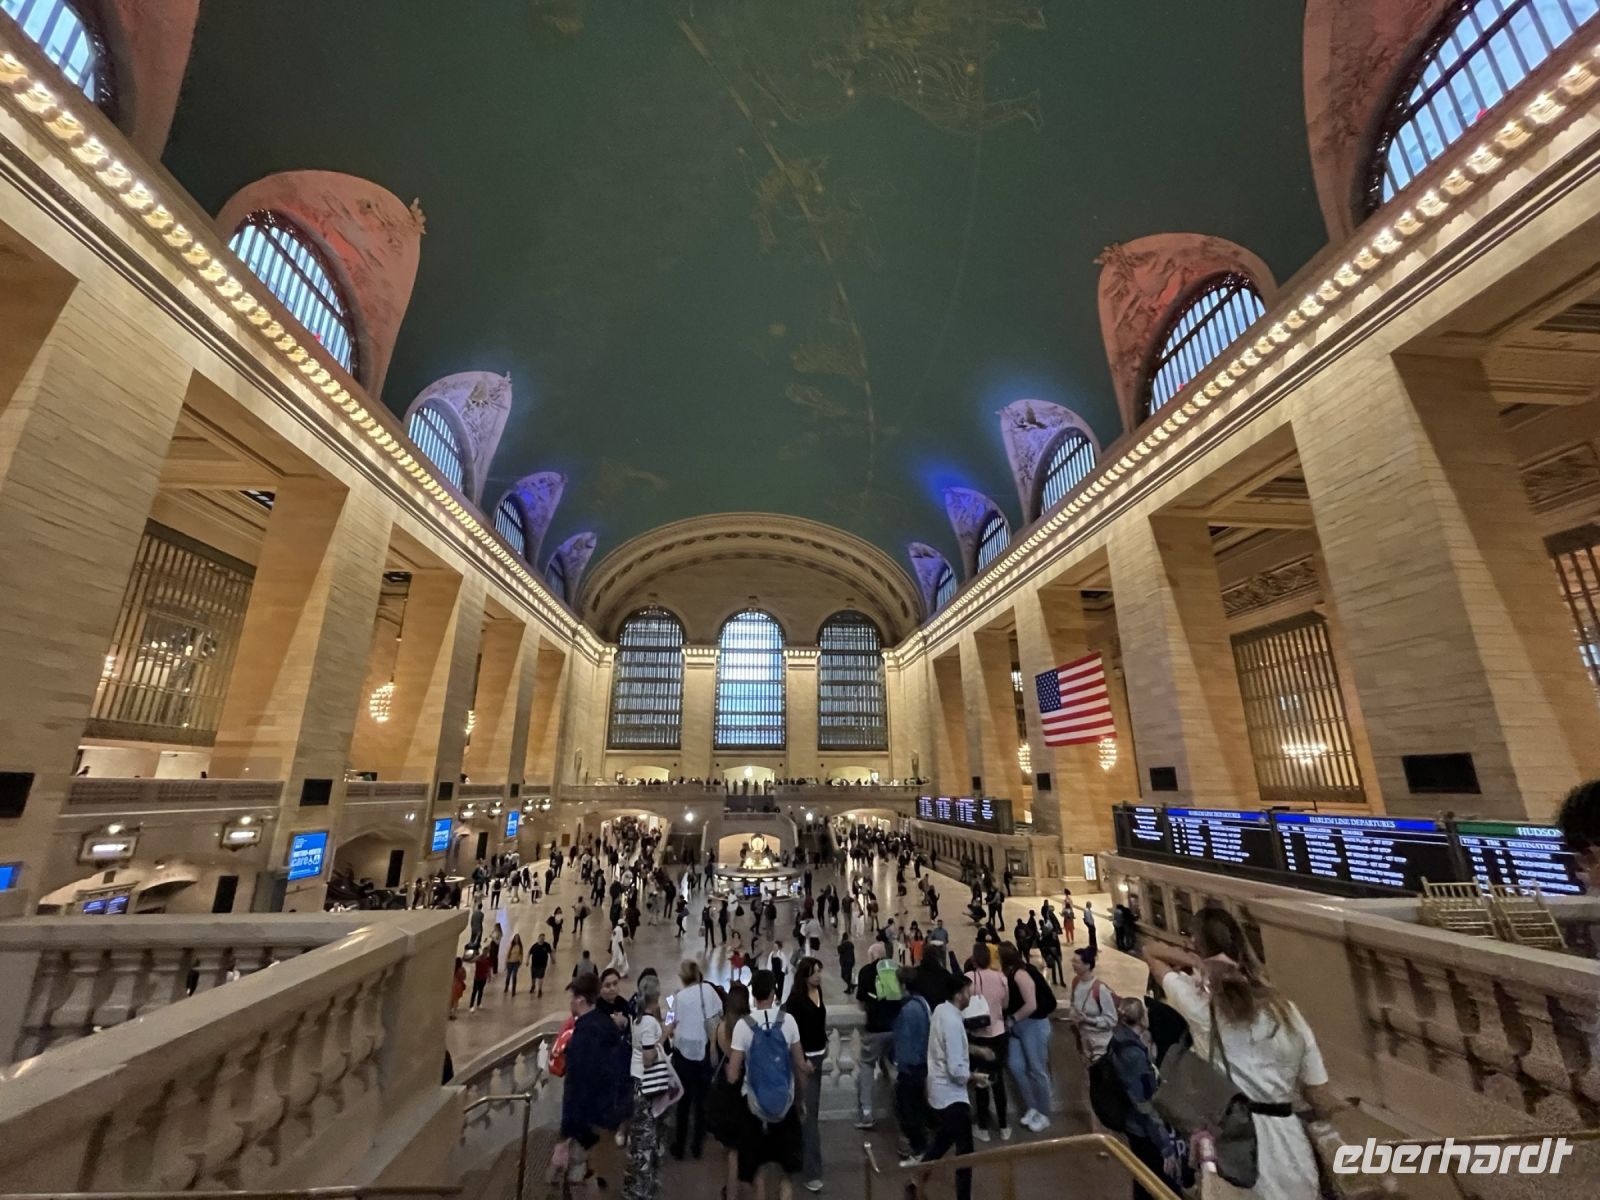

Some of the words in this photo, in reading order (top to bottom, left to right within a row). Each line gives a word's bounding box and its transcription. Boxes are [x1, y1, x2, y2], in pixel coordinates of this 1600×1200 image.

[1309, 816, 1335, 824] HARLEM
[1335, 817, 1350, 825] LINE
[1351, 818, 1395, 828] DEPARTURES
[1507, 841, 1561, 851] DESTINATION
